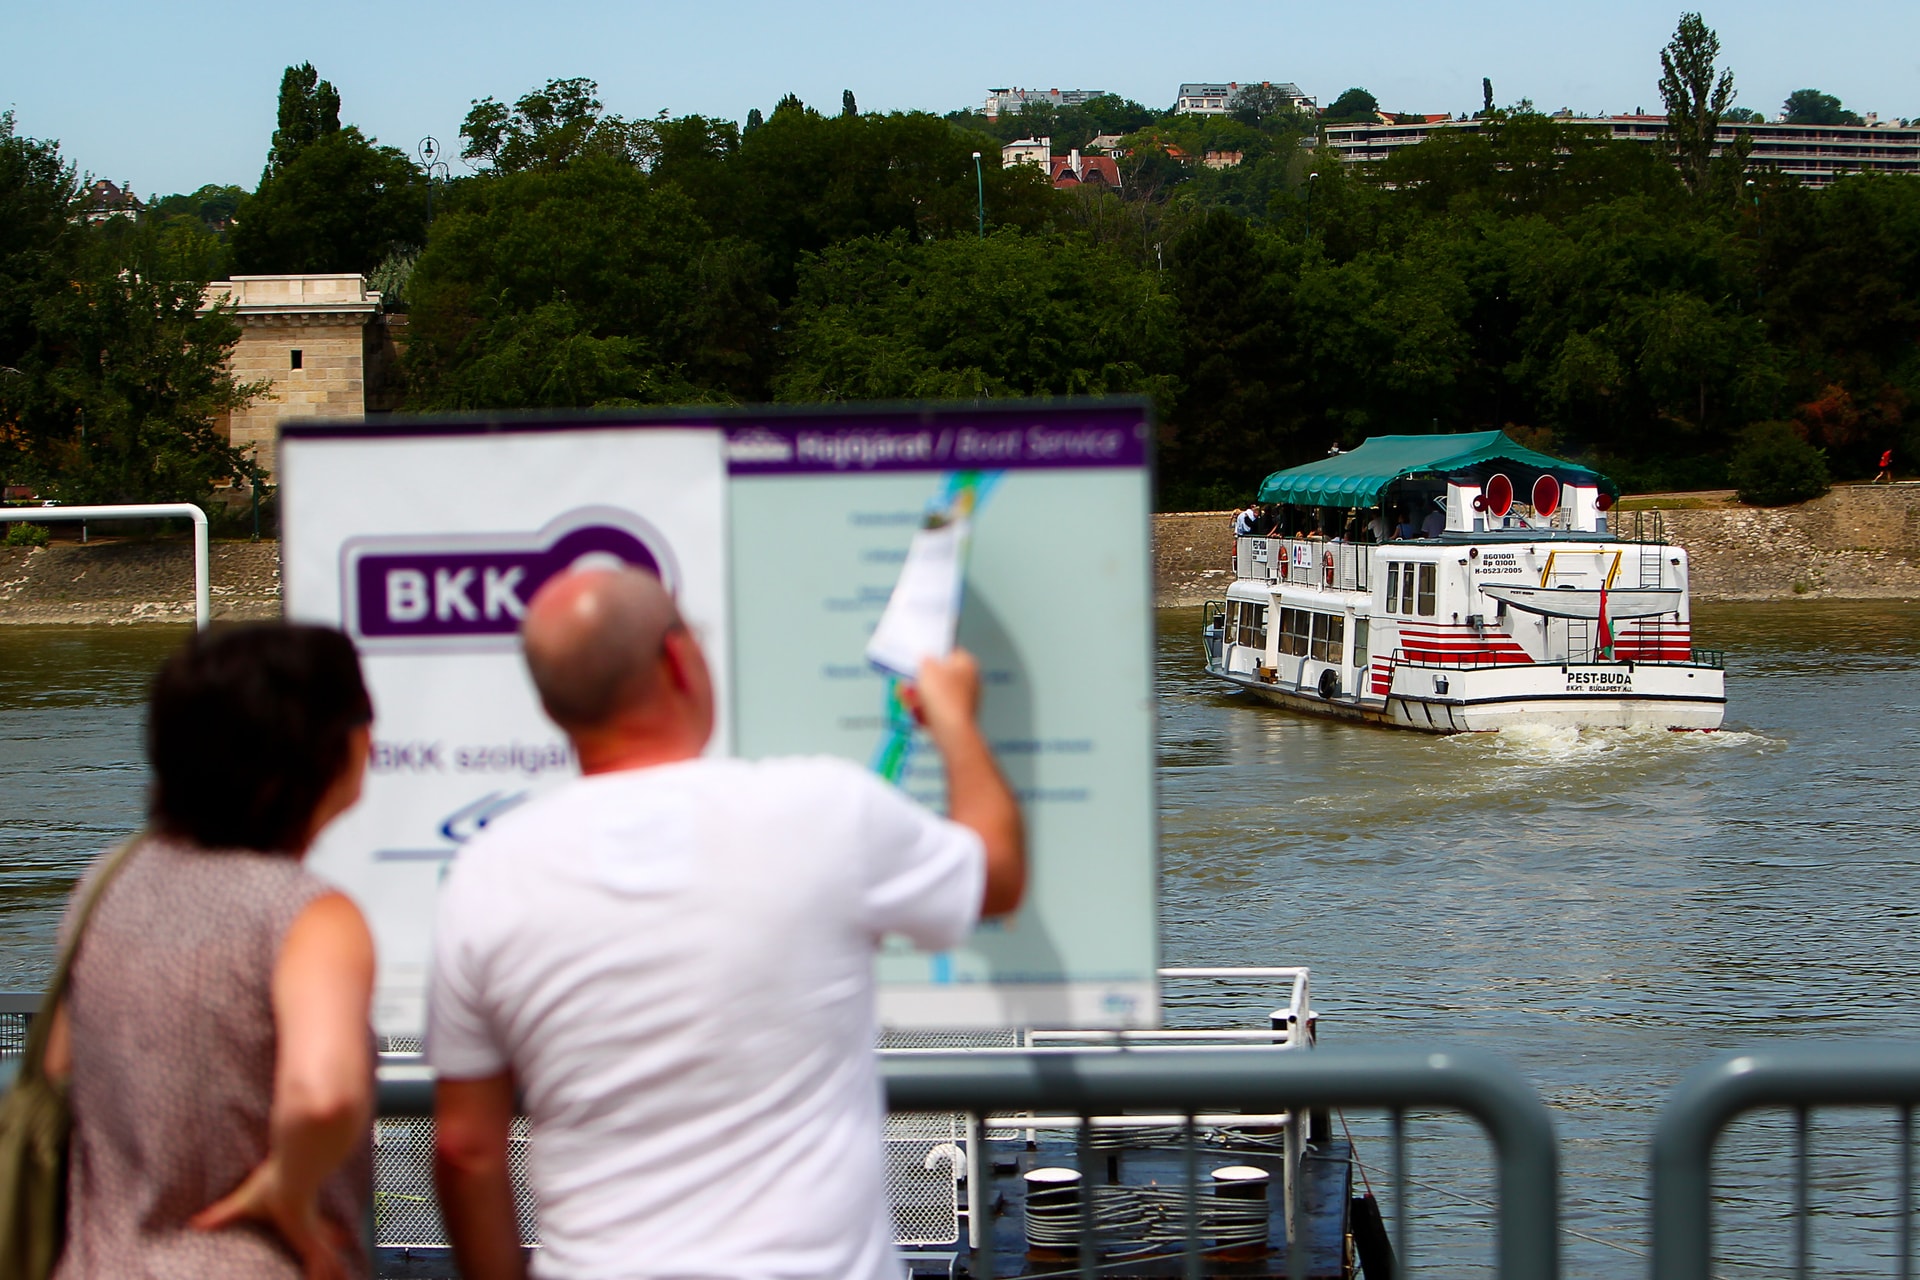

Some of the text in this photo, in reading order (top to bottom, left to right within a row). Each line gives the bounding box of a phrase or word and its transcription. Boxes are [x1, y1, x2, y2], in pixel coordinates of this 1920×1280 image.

[1023, 424, 1125, 460] Service
[385, 565, 530, 623] BKK
[369, 738, 573, 778] BKK szolgál
